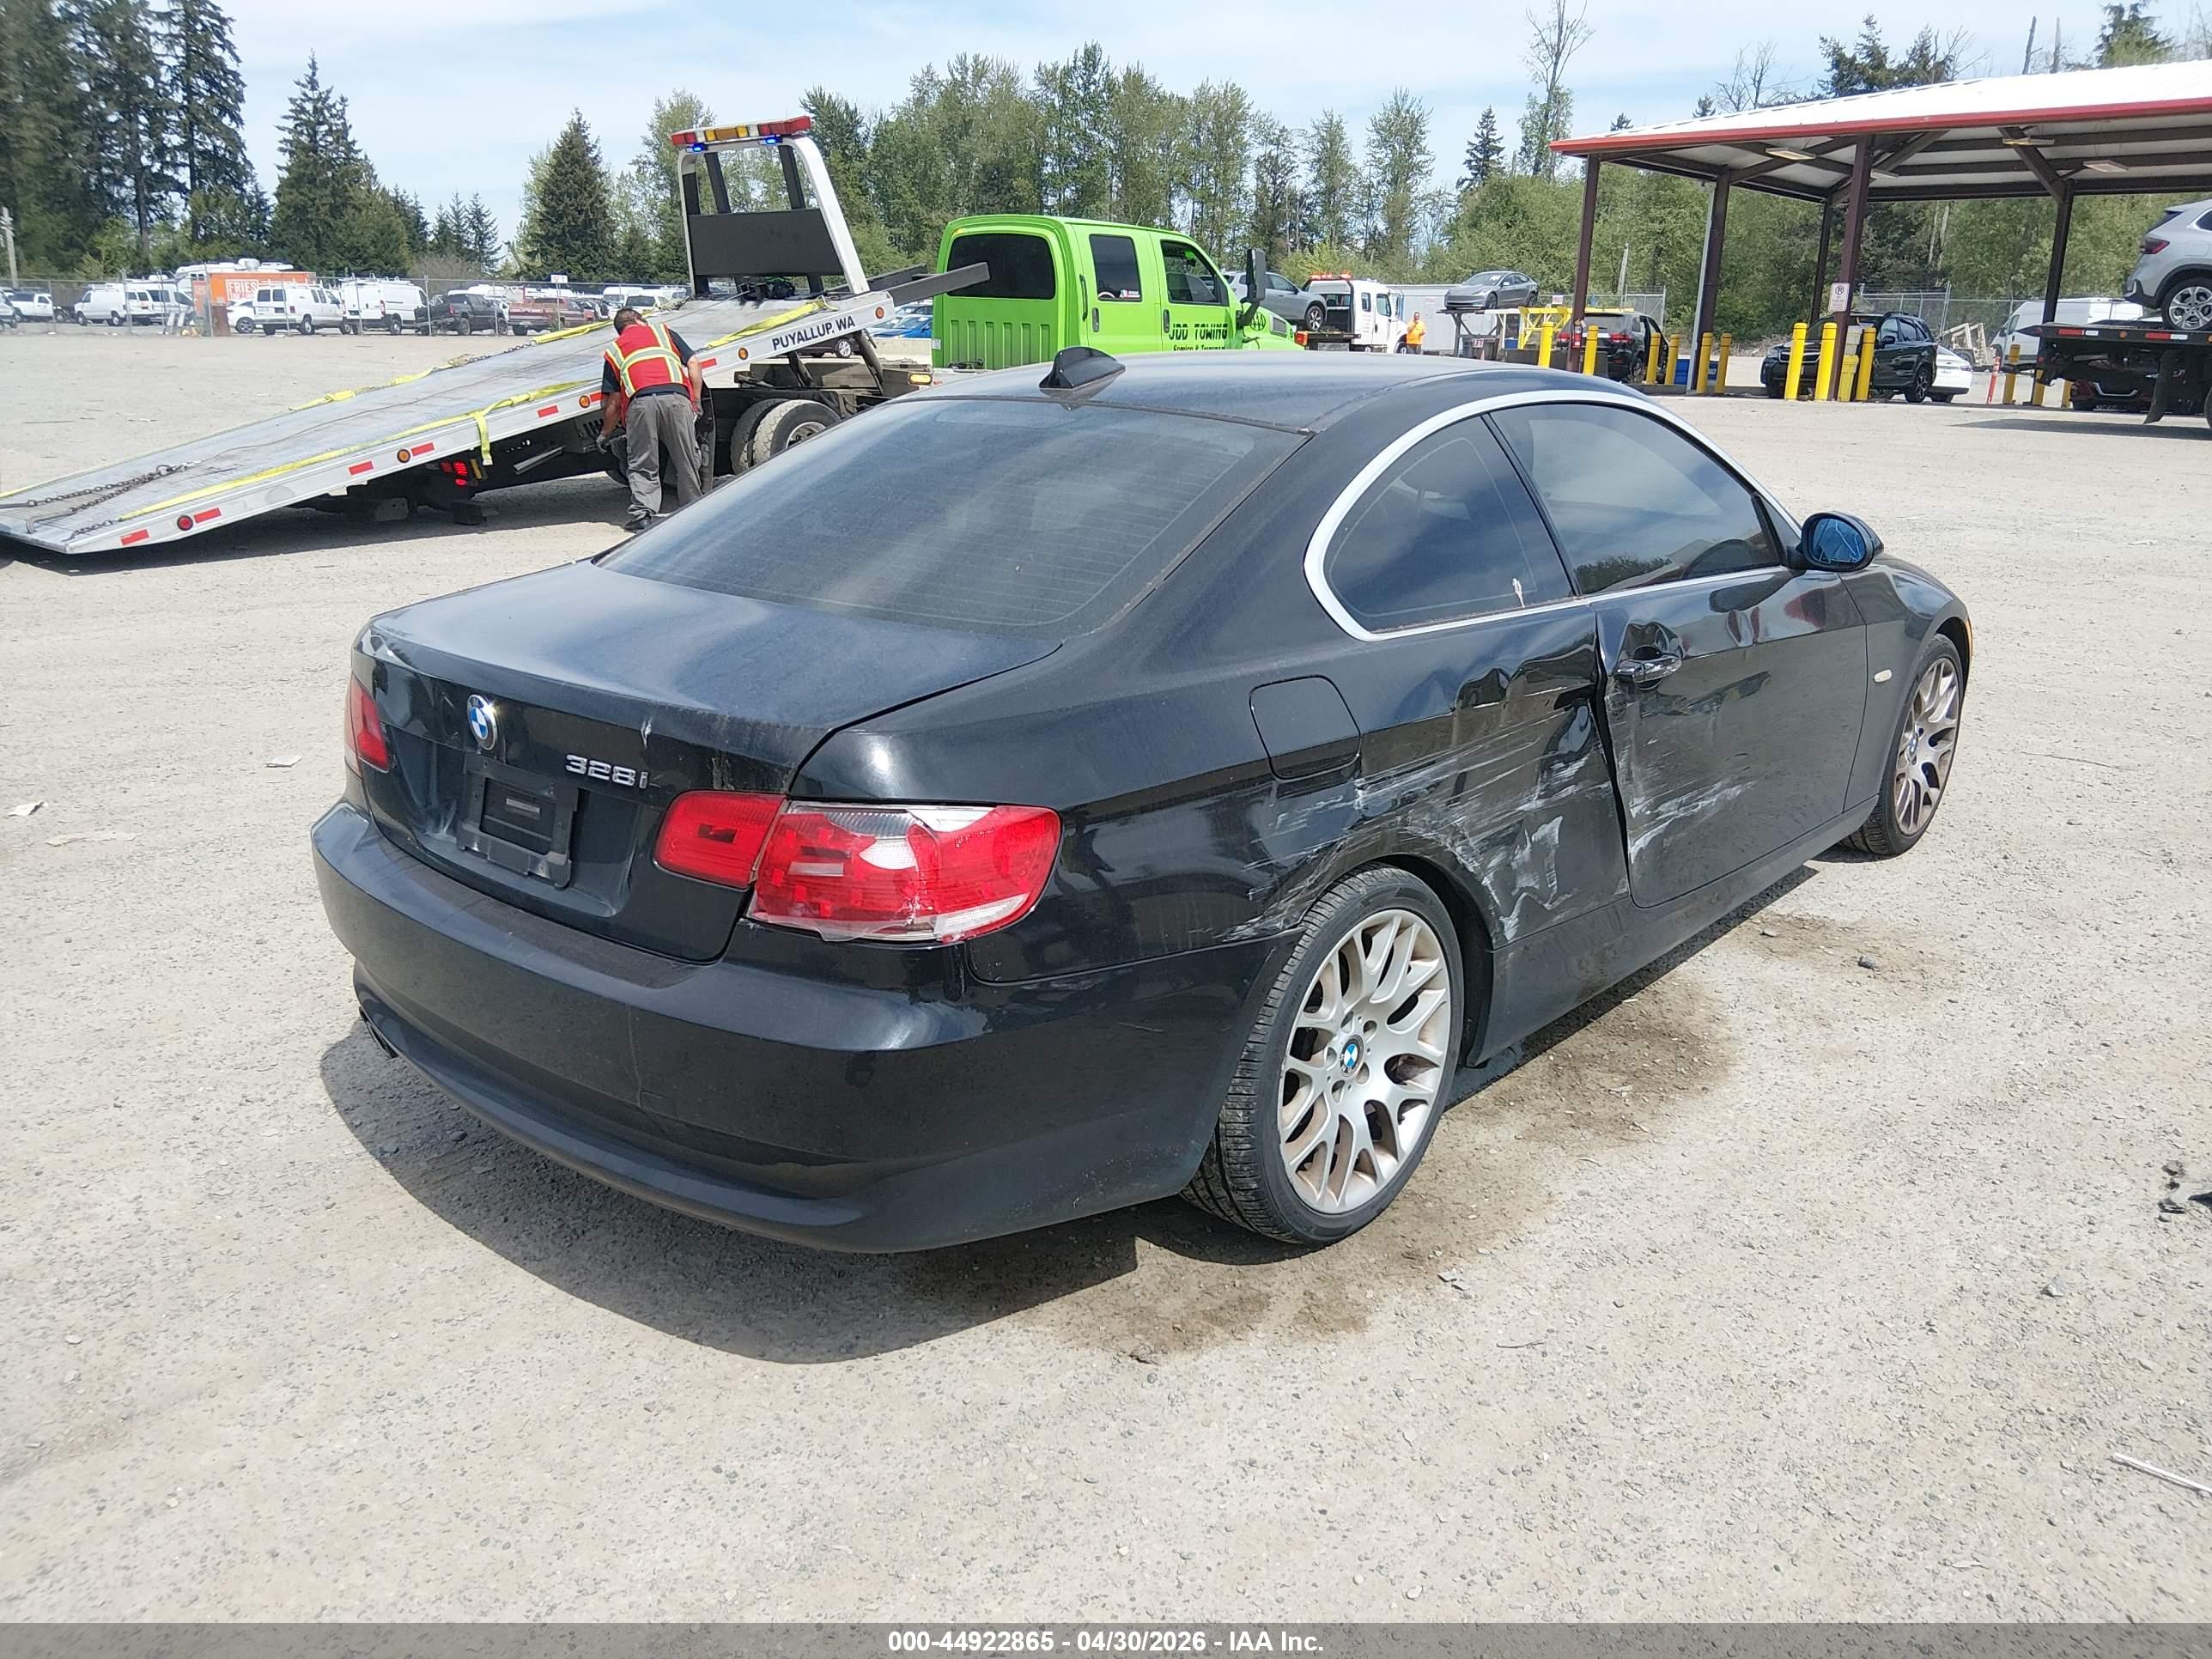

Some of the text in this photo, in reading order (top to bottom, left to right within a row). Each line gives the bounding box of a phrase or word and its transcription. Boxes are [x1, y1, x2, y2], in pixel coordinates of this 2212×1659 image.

[228, 281, 257, 293] FRIES
[836, 315, 856, 331] WA
[1194, 323, 1228, 340] TOWING
[565, 753, 650, 789] 328i
